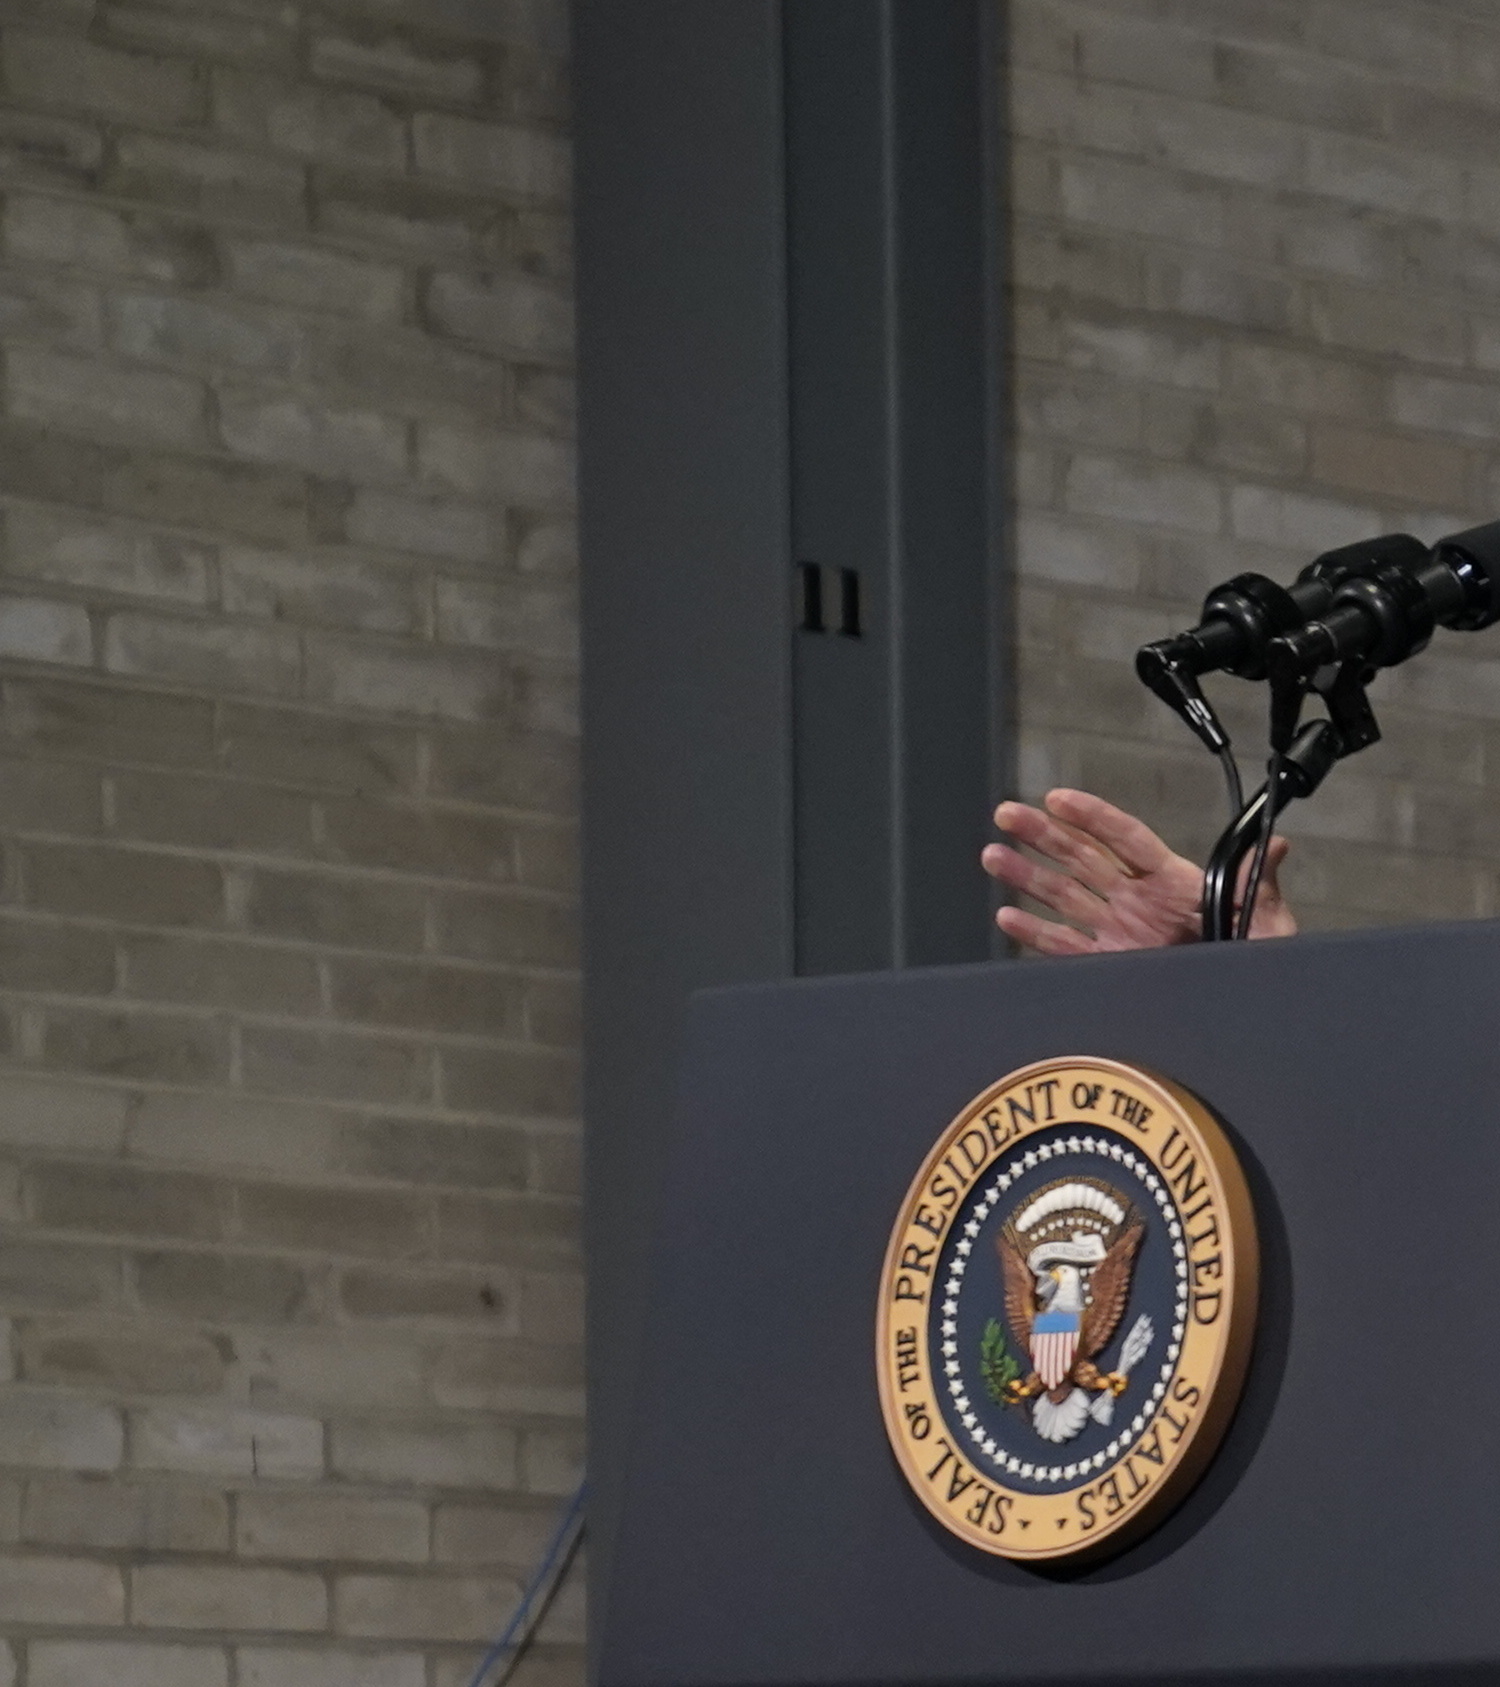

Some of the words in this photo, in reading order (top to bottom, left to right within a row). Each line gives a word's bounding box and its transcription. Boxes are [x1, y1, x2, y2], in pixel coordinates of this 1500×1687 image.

[1071, 1082, 1103, 1111] OF
[1111, 1089, 1154, 1134] THE
[893, 1080, 1061, 1305] PRESIDENT
[1157, 1126, 1223, 1326] UNITED
[895, 1326, 921, 1392] THE
[905, 1402, 932, 1441] OF
[1076, 1376, 1201, 1530] STATES
[927, 1436, 1013, 1535] SEAL
